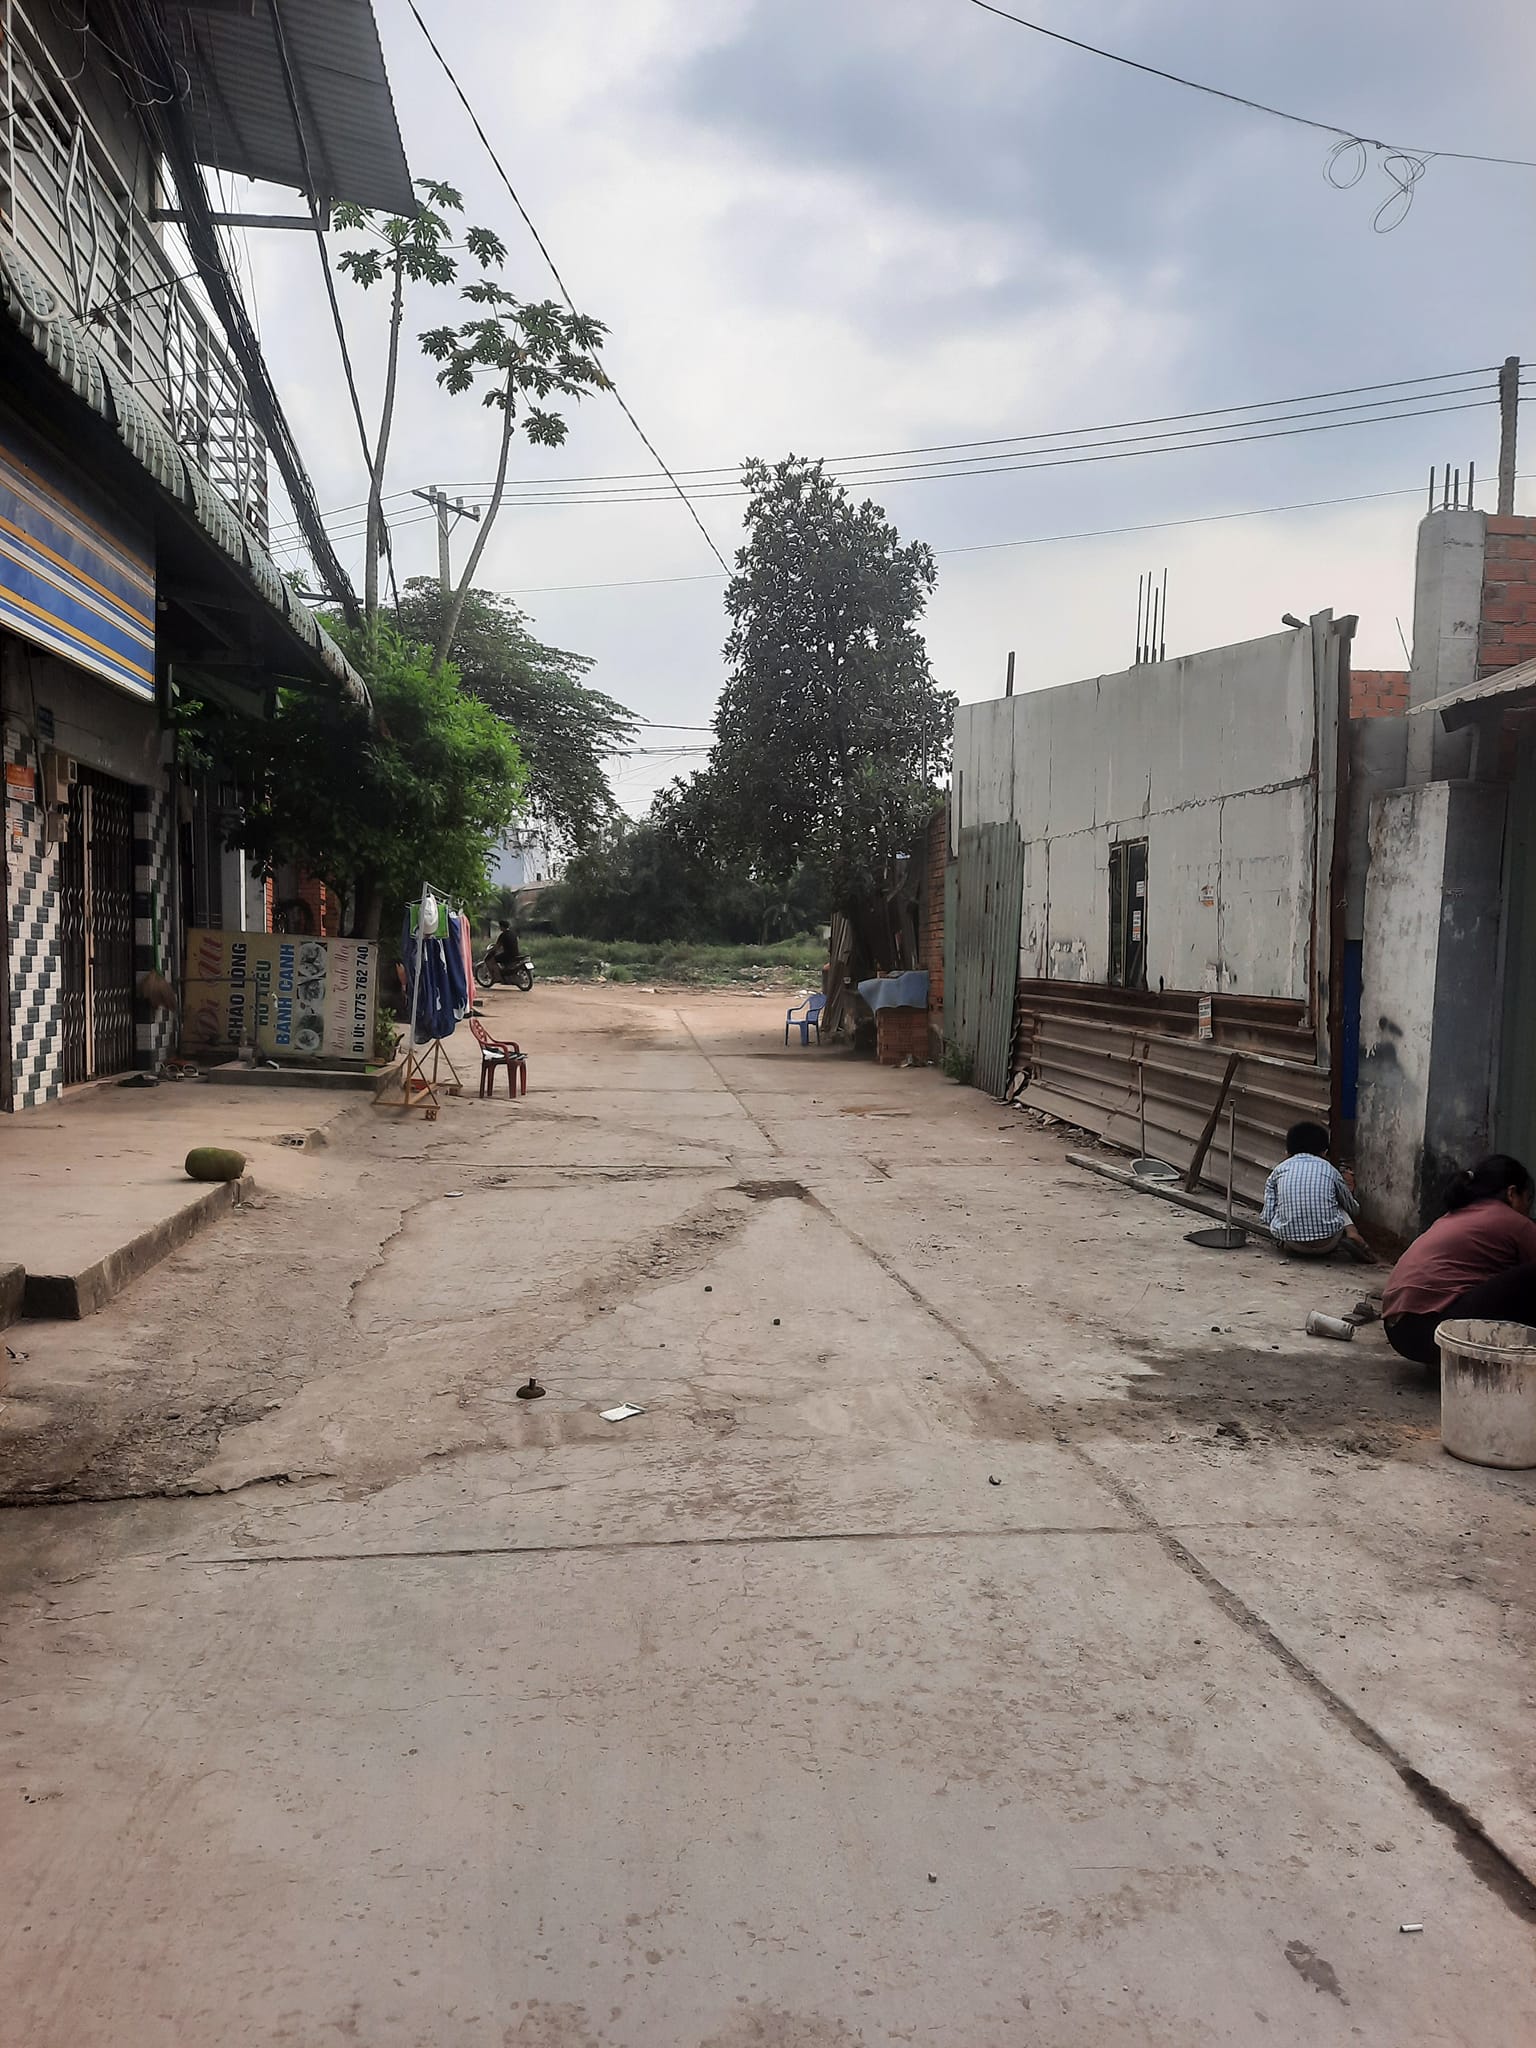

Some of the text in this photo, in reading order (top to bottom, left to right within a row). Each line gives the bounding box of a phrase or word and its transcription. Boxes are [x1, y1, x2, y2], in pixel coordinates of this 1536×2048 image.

[357, 946, 369, 967] 740
[356, 970, 368, 990] 762
[273, 944, 295, 1044] BÁNH CANH
[354, 993, 367, 1020] 0775
